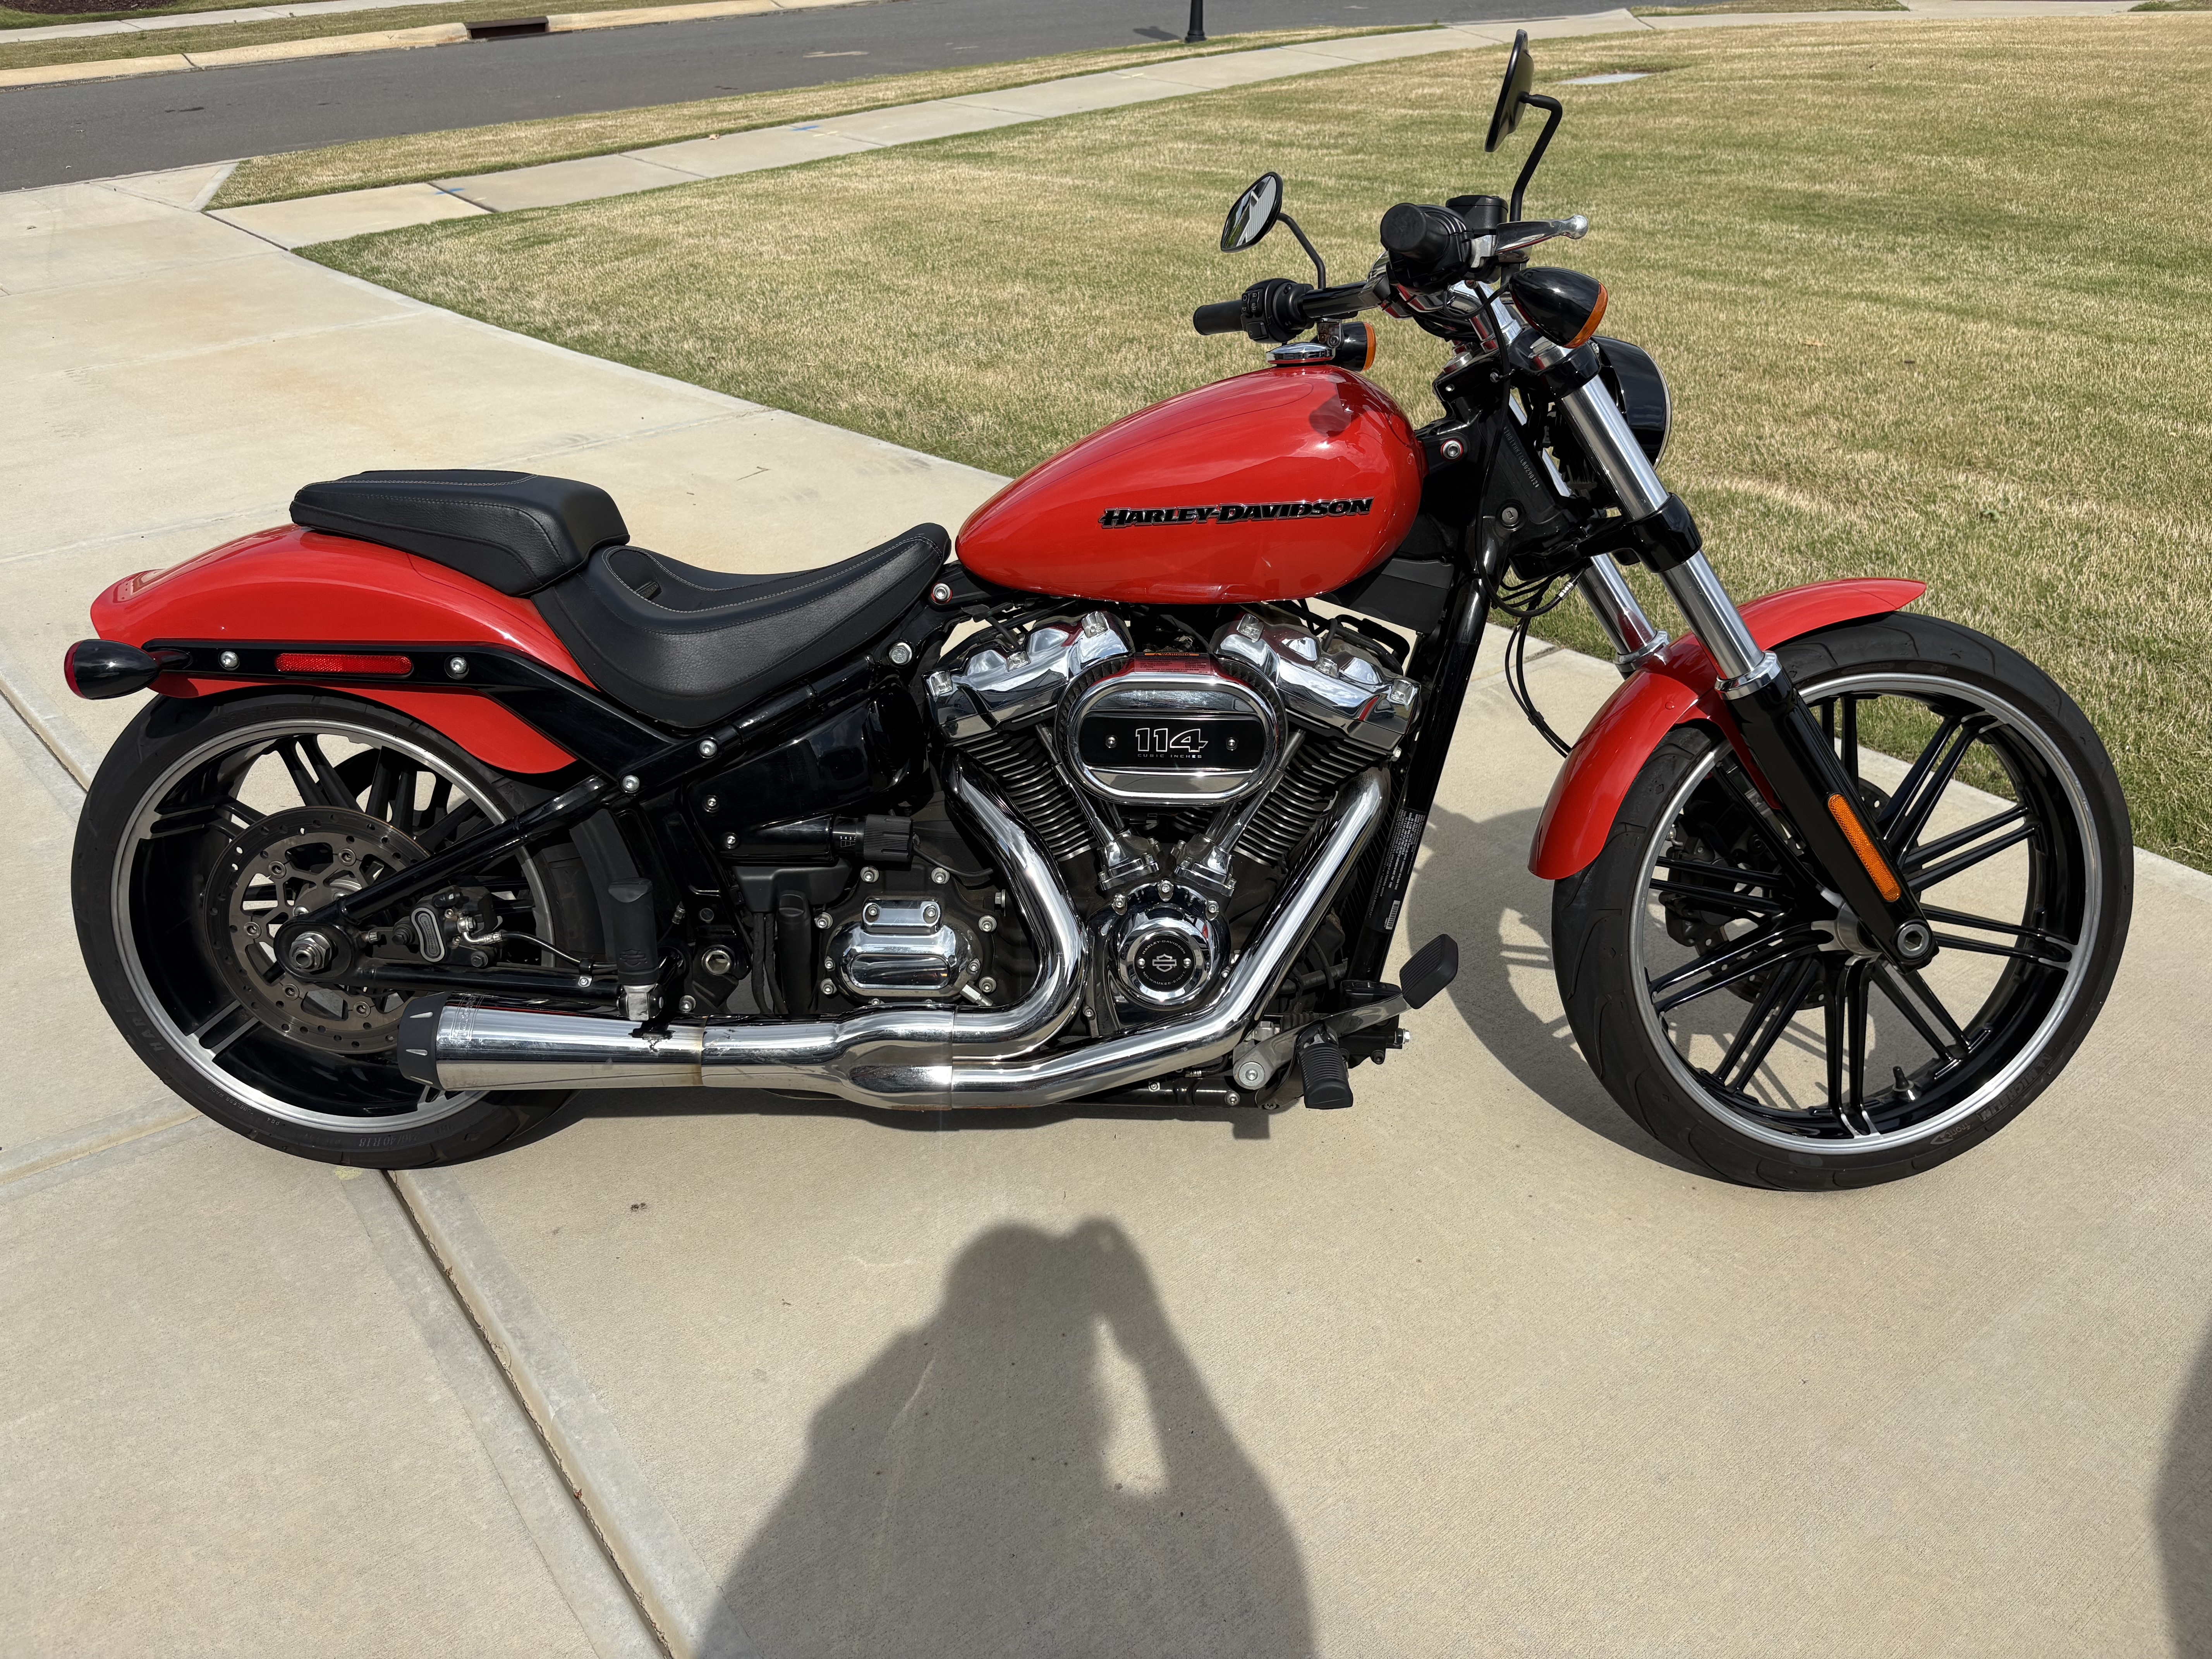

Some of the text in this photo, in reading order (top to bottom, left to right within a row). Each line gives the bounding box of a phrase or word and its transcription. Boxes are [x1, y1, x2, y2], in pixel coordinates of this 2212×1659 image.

[1099, 496, 1375, 529] HARLEY-DAVIDSON
[1135, 728, 1208, 752] 114
[1142, 940, 1186, 955] HARLEY-DAVIDSON
[1143, 971, 1186, 986] MILWAUKEE-EIGHT
[1979, 1068, 2039, 1120] MICHELIN
